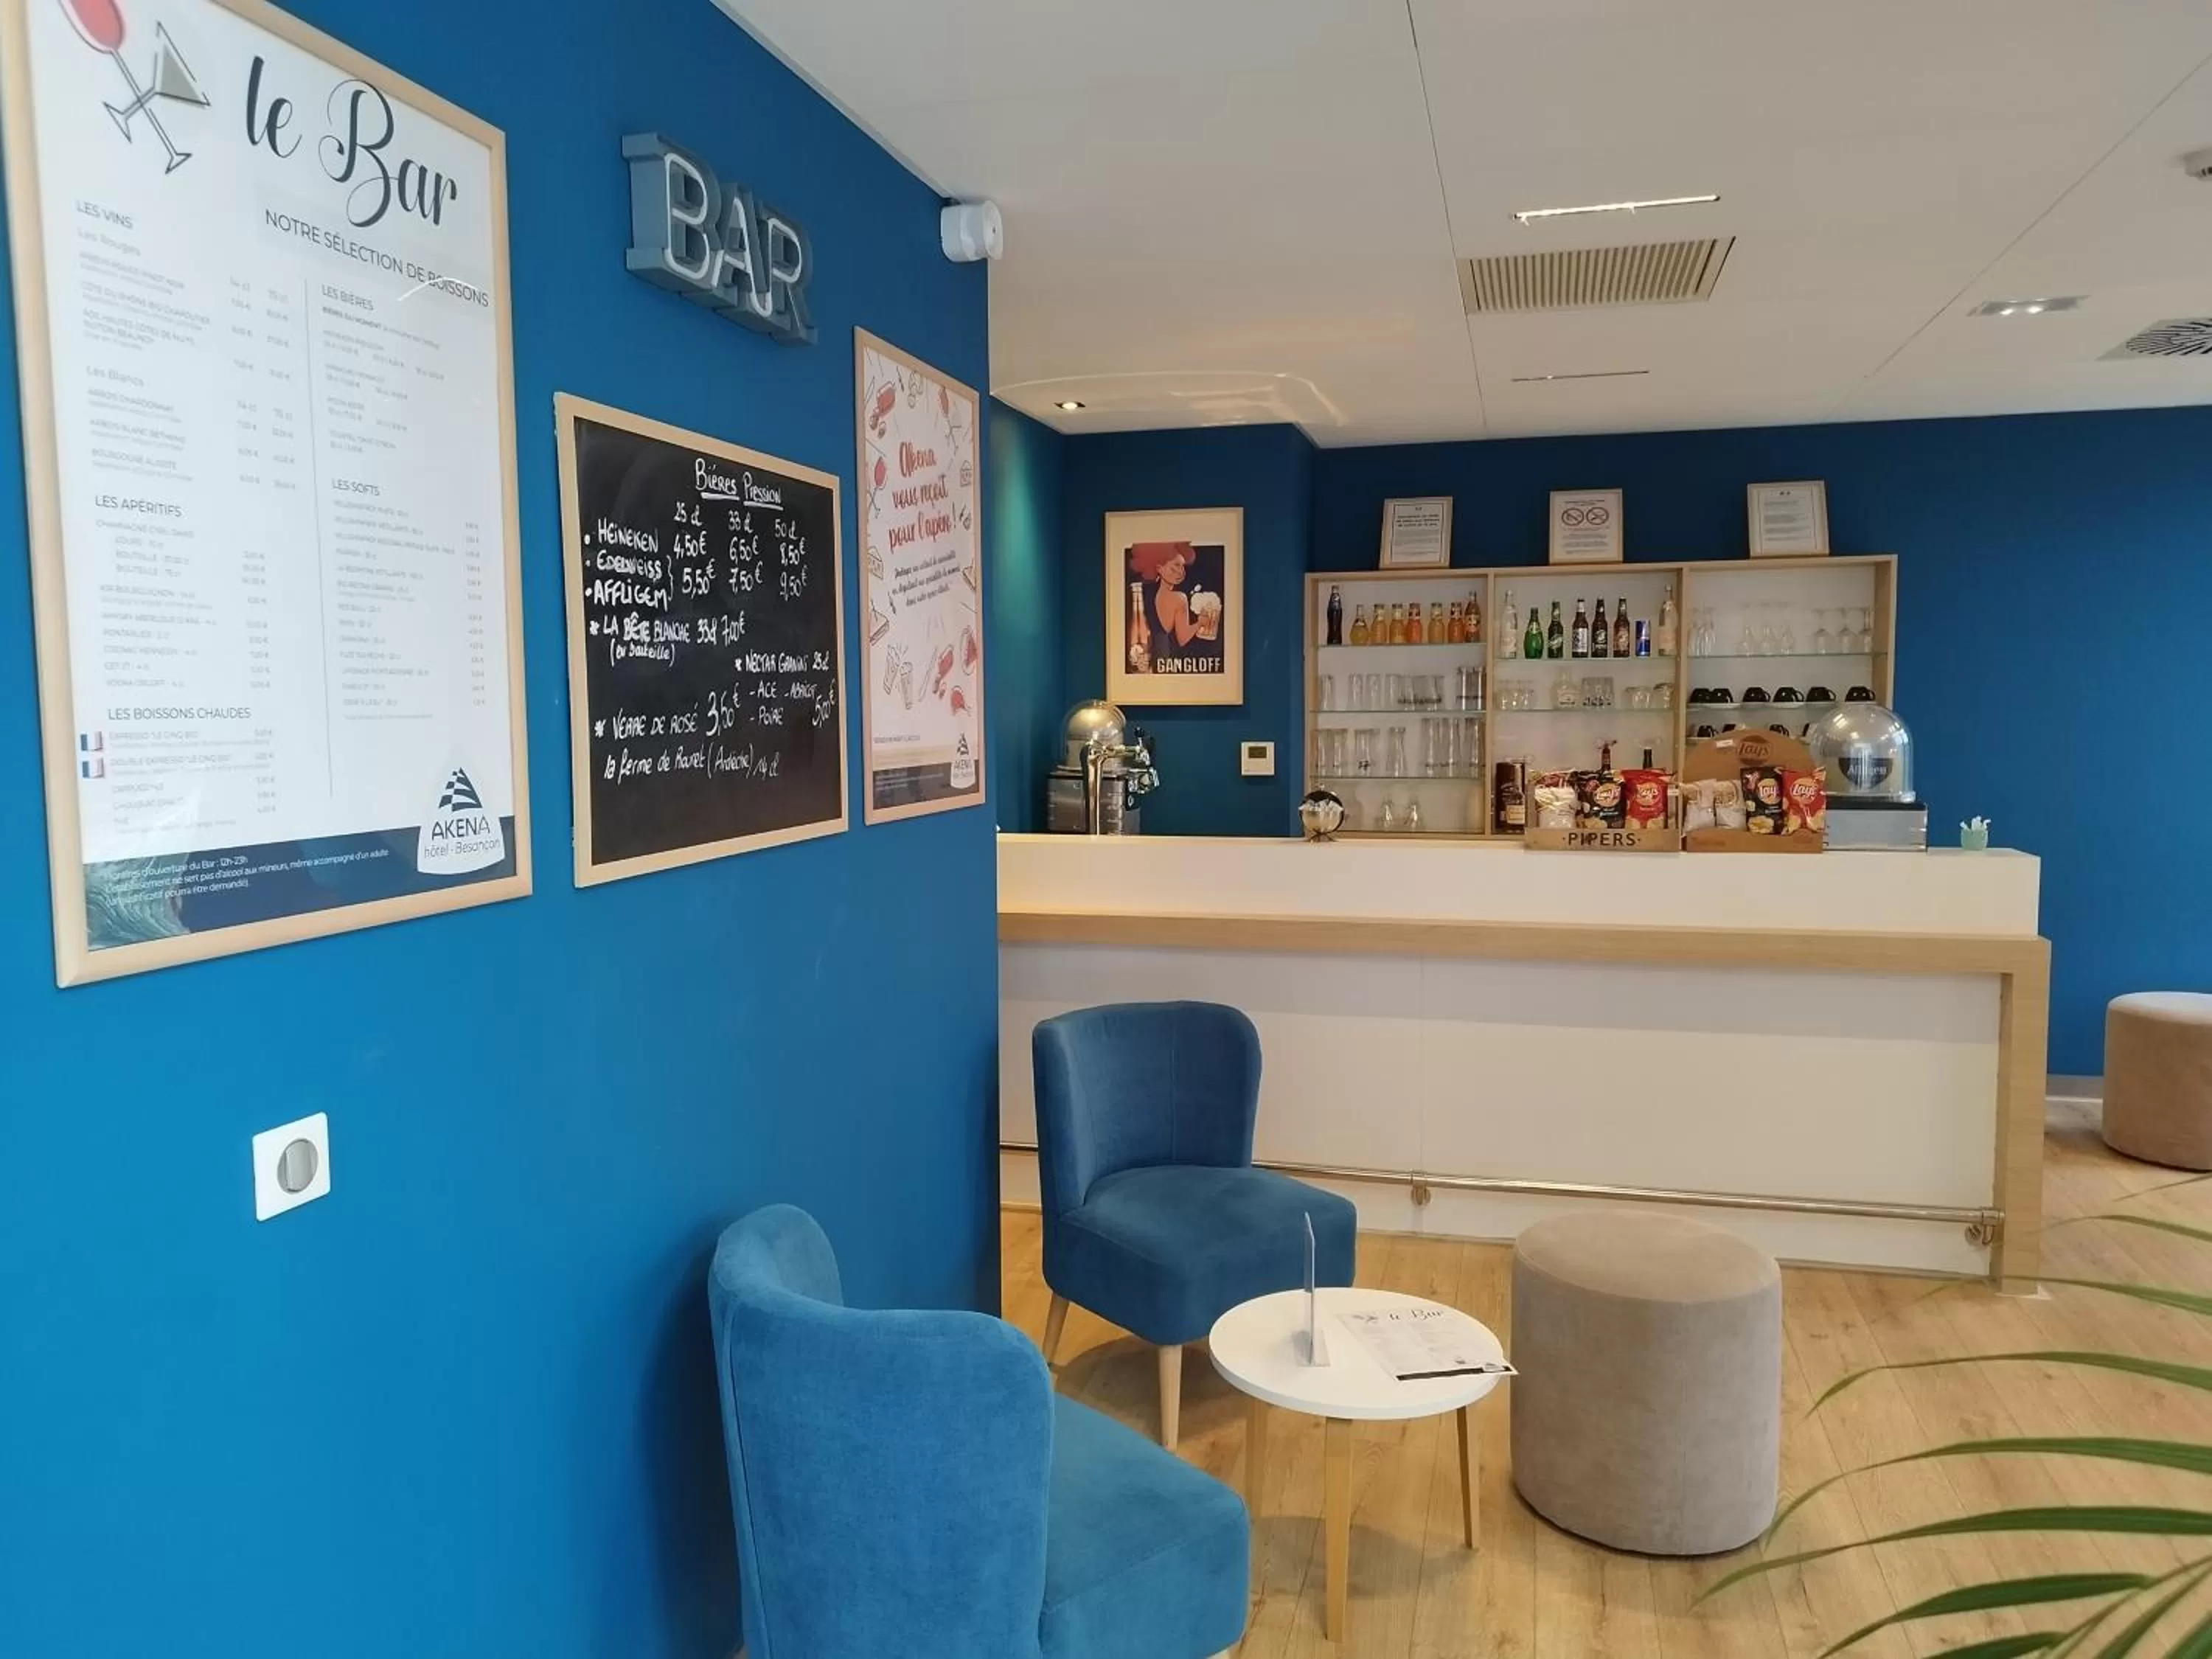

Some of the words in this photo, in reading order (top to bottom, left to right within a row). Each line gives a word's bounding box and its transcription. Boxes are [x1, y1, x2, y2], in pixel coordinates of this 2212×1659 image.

[246, 55, 302, 159] le
[319, 79, 457, 228] Bar
[77, 200, 100, 218] LES
[101, 207, 133, 230] VINS
[634, 140, 815, 341] BAR
[265, 209, 320, 244] NOTRE
[324, 231, 403, 274] SÉLECTION
[406, 262, 425, 282] DE
[428, 271, 490, 307] BOISSONS
[321, 284, 338, 299] LES
[340, 288, 375, 311] BIÈRES
[331, 478, 349, 490] LES
[351, 481, 380, 496] SOFTS
[892, 486, 918, 509] vous
[95, 494, 118, 509] LES
[121, 495, 183, 518] APÉRITIFS
[674, 501, 687, 523] 25
[728, 509, 741, 531] 33
[775, 518, 787, 538] 50
[674, 530, 707, 559] 4,50€
[779, 536, 806, 566] 8,50€
[888, 523, 915, 554] pour
[682, 557, 717, 599] 5,50€
[728, 560, 763, 595] 7,50€
[779, 564, 808, 602] 9,50€
[603, 614, 619, 636] LA
[1157, 657, 1221, 673] GANGLOFF
[108, 707, 131, 720] LES
[133, 707, 195, 720] BOISSONS
[197, 706, 252, 720] CHAUDES
[650, 715, 666, 735] DE
[669, 701, 698, 734] ROSÉ
[706, 681, 741, 737] 3,50€
[604, 754, 616, 779] la
[617, 747, 653, 787] ferme
[658, 749, 670, 772] de
[431, 814, 491, 841] AKENA
[1568, 832, 1635, 846] PIPERS
[189, 862, 201, 871] du
